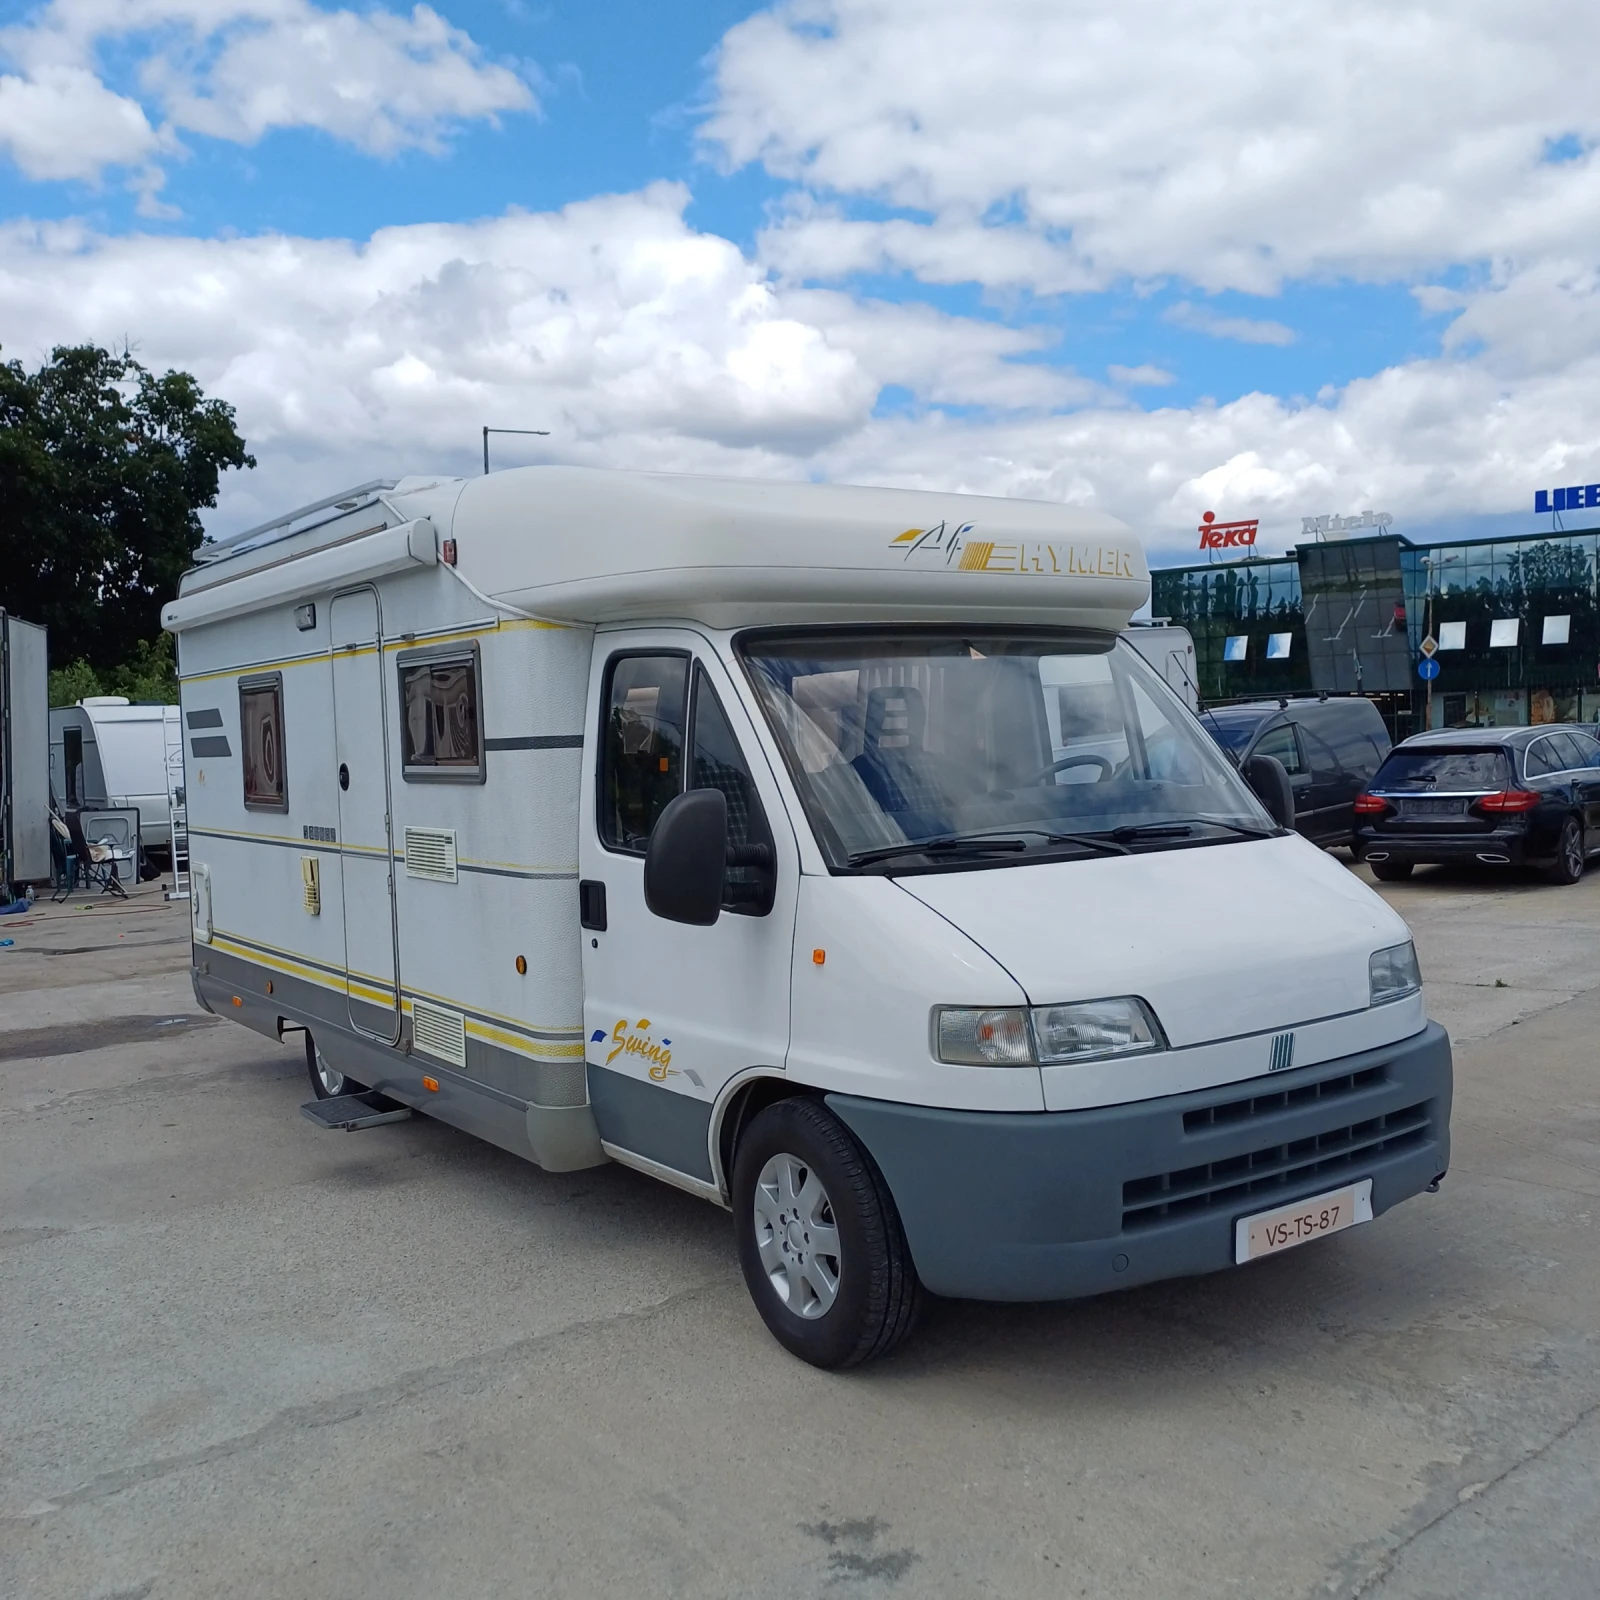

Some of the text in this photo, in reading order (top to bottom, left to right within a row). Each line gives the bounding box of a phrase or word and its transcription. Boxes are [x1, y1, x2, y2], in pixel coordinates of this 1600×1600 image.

[1301, 510, 1393, 534] Miele
[605, 1018, 682, 1082] Swing
[1265, 1206, 1341, 1247] VS-TS-87
